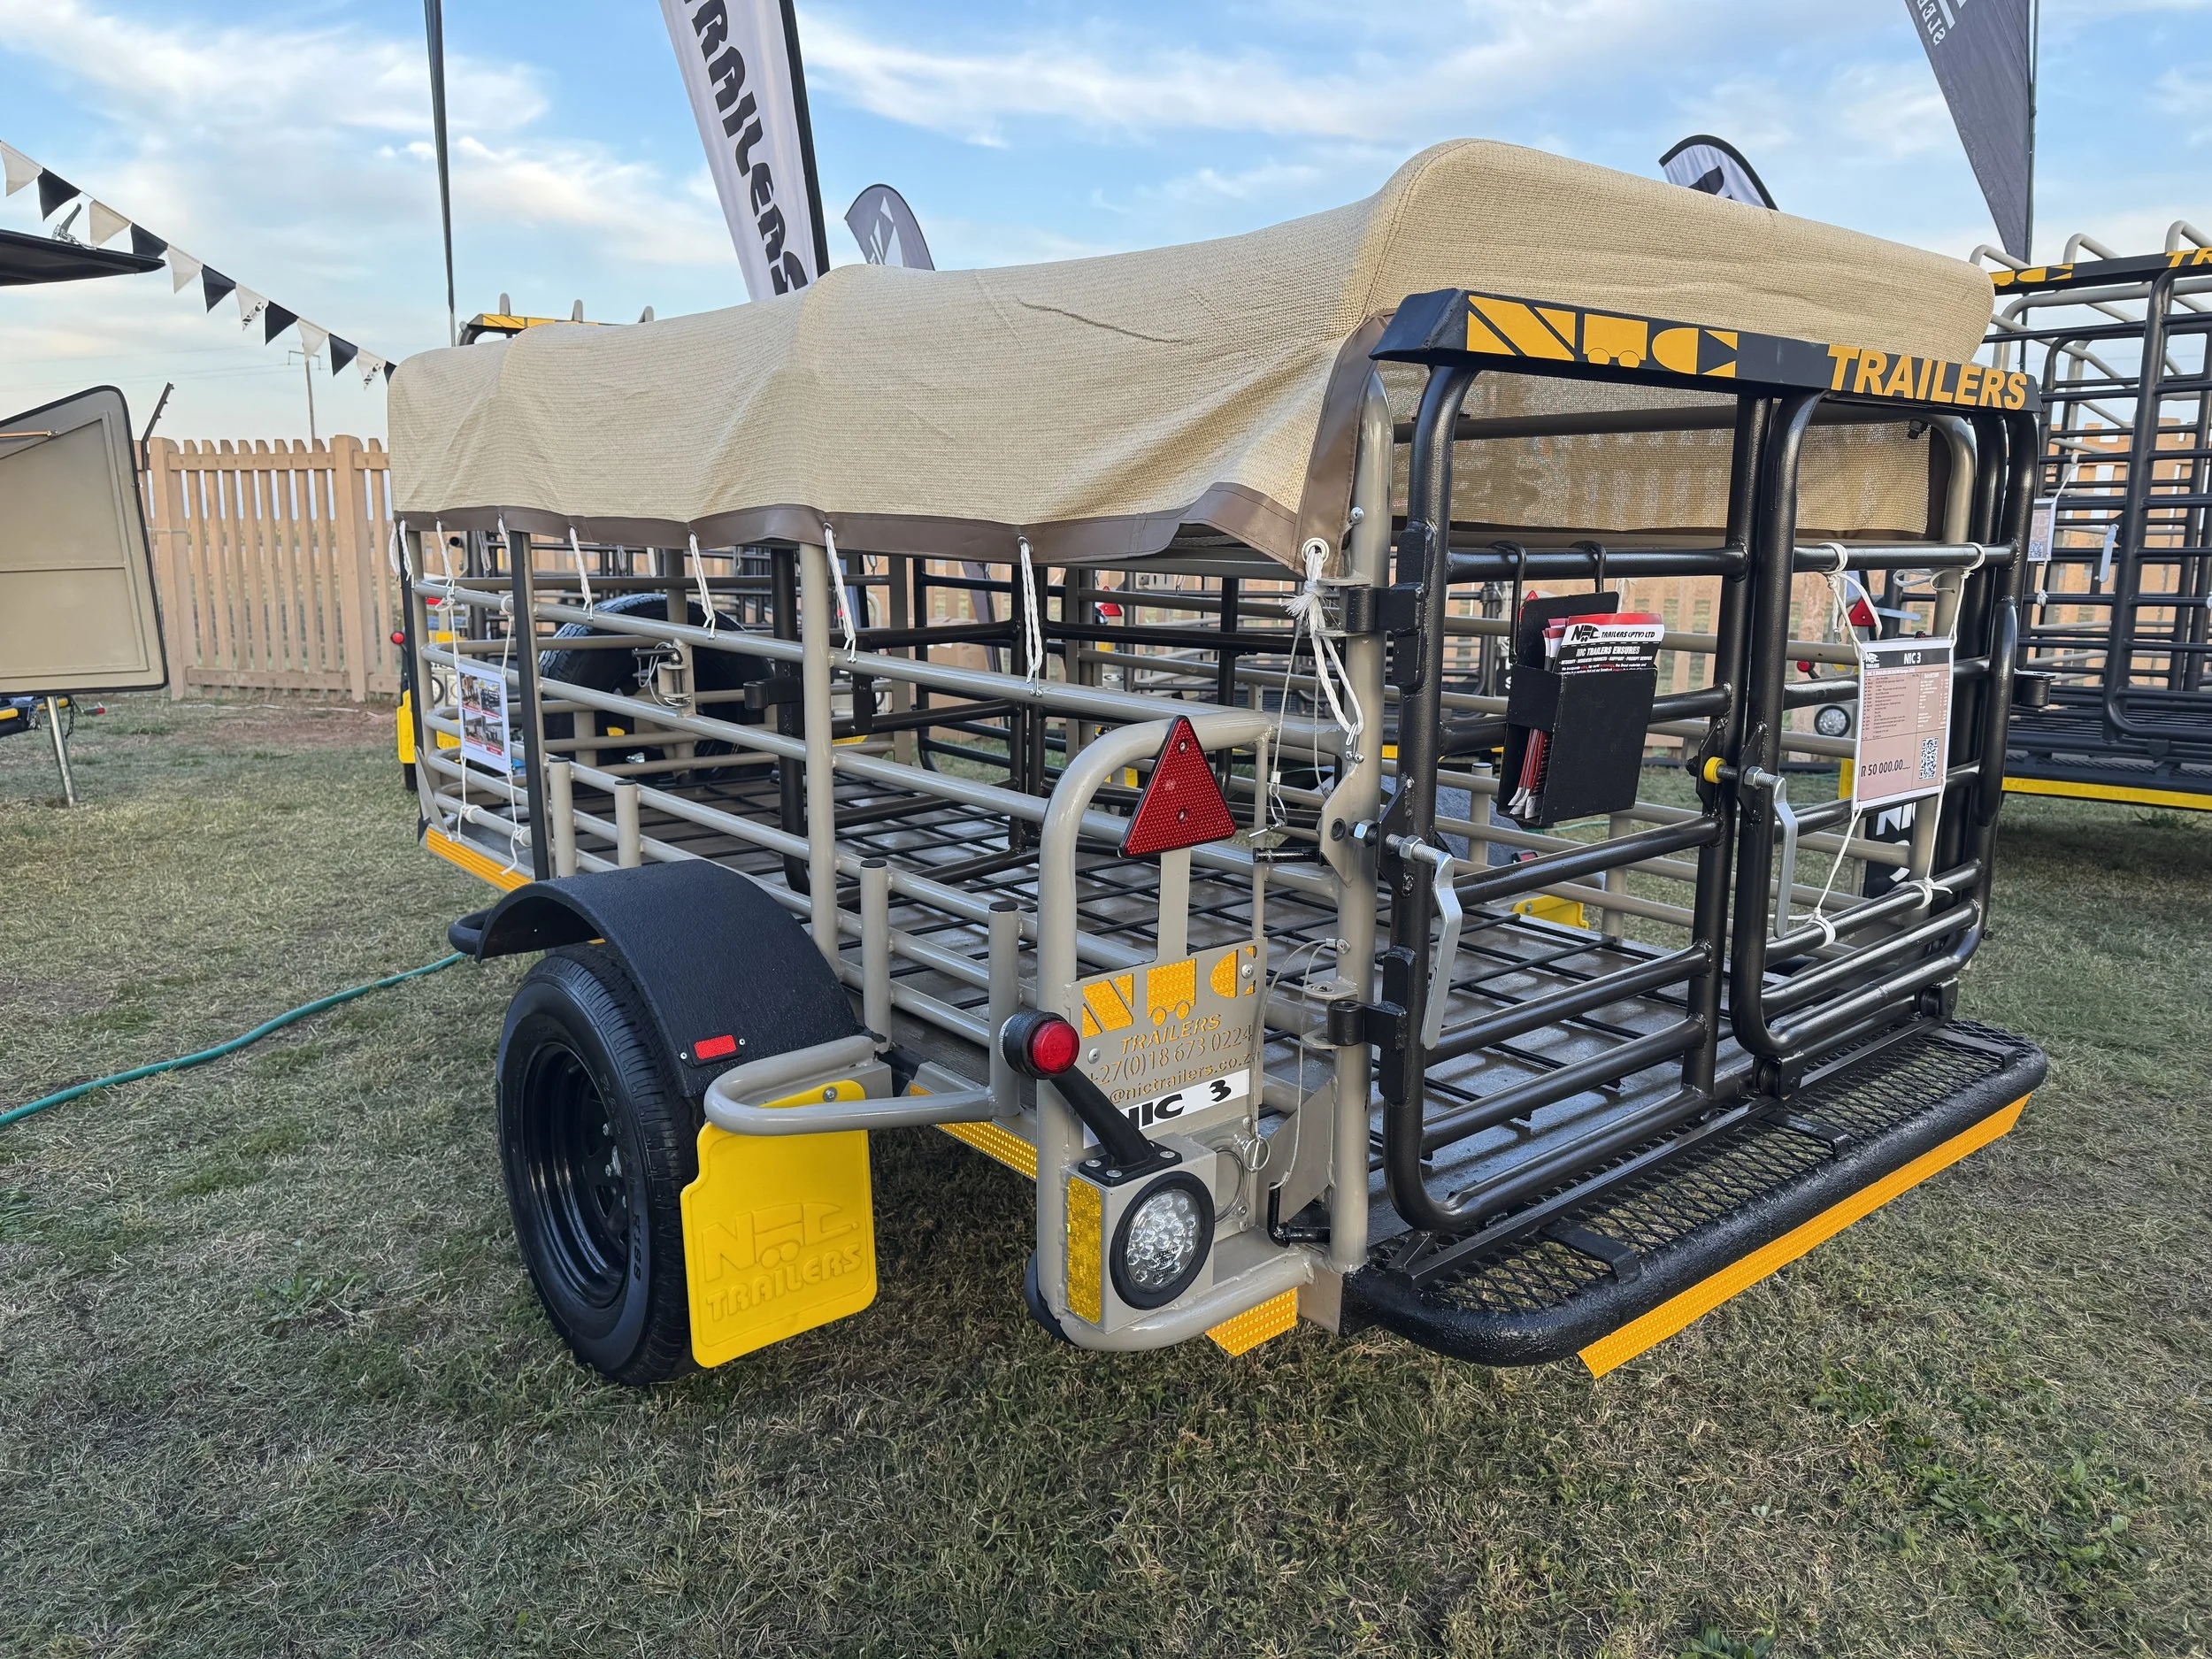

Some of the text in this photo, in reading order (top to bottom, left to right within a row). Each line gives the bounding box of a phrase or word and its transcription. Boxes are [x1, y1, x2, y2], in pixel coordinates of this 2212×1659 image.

[683, 0, 808, 296] RAILERS
[1827, 344, 2028, 410] TRAILERS
[1587, 647, 1612, 657] TRAILERS
[1612, 646, 1640, 655] ENSURES
[1903, 652, 1922, 664] NIC 3
[1861, 765, 1866, 778] R
[1868, 764, 1877, 776] 50
[1120, 1014, 1221, 1055] TRAILERS
[1174, 1037, 1206, 1063] 673
[1210, 1025, 1253, 1053] 0224
[1209, 1079, 1232, 1102] 3
[706, 1241, 864, 1323] TRAILERS
